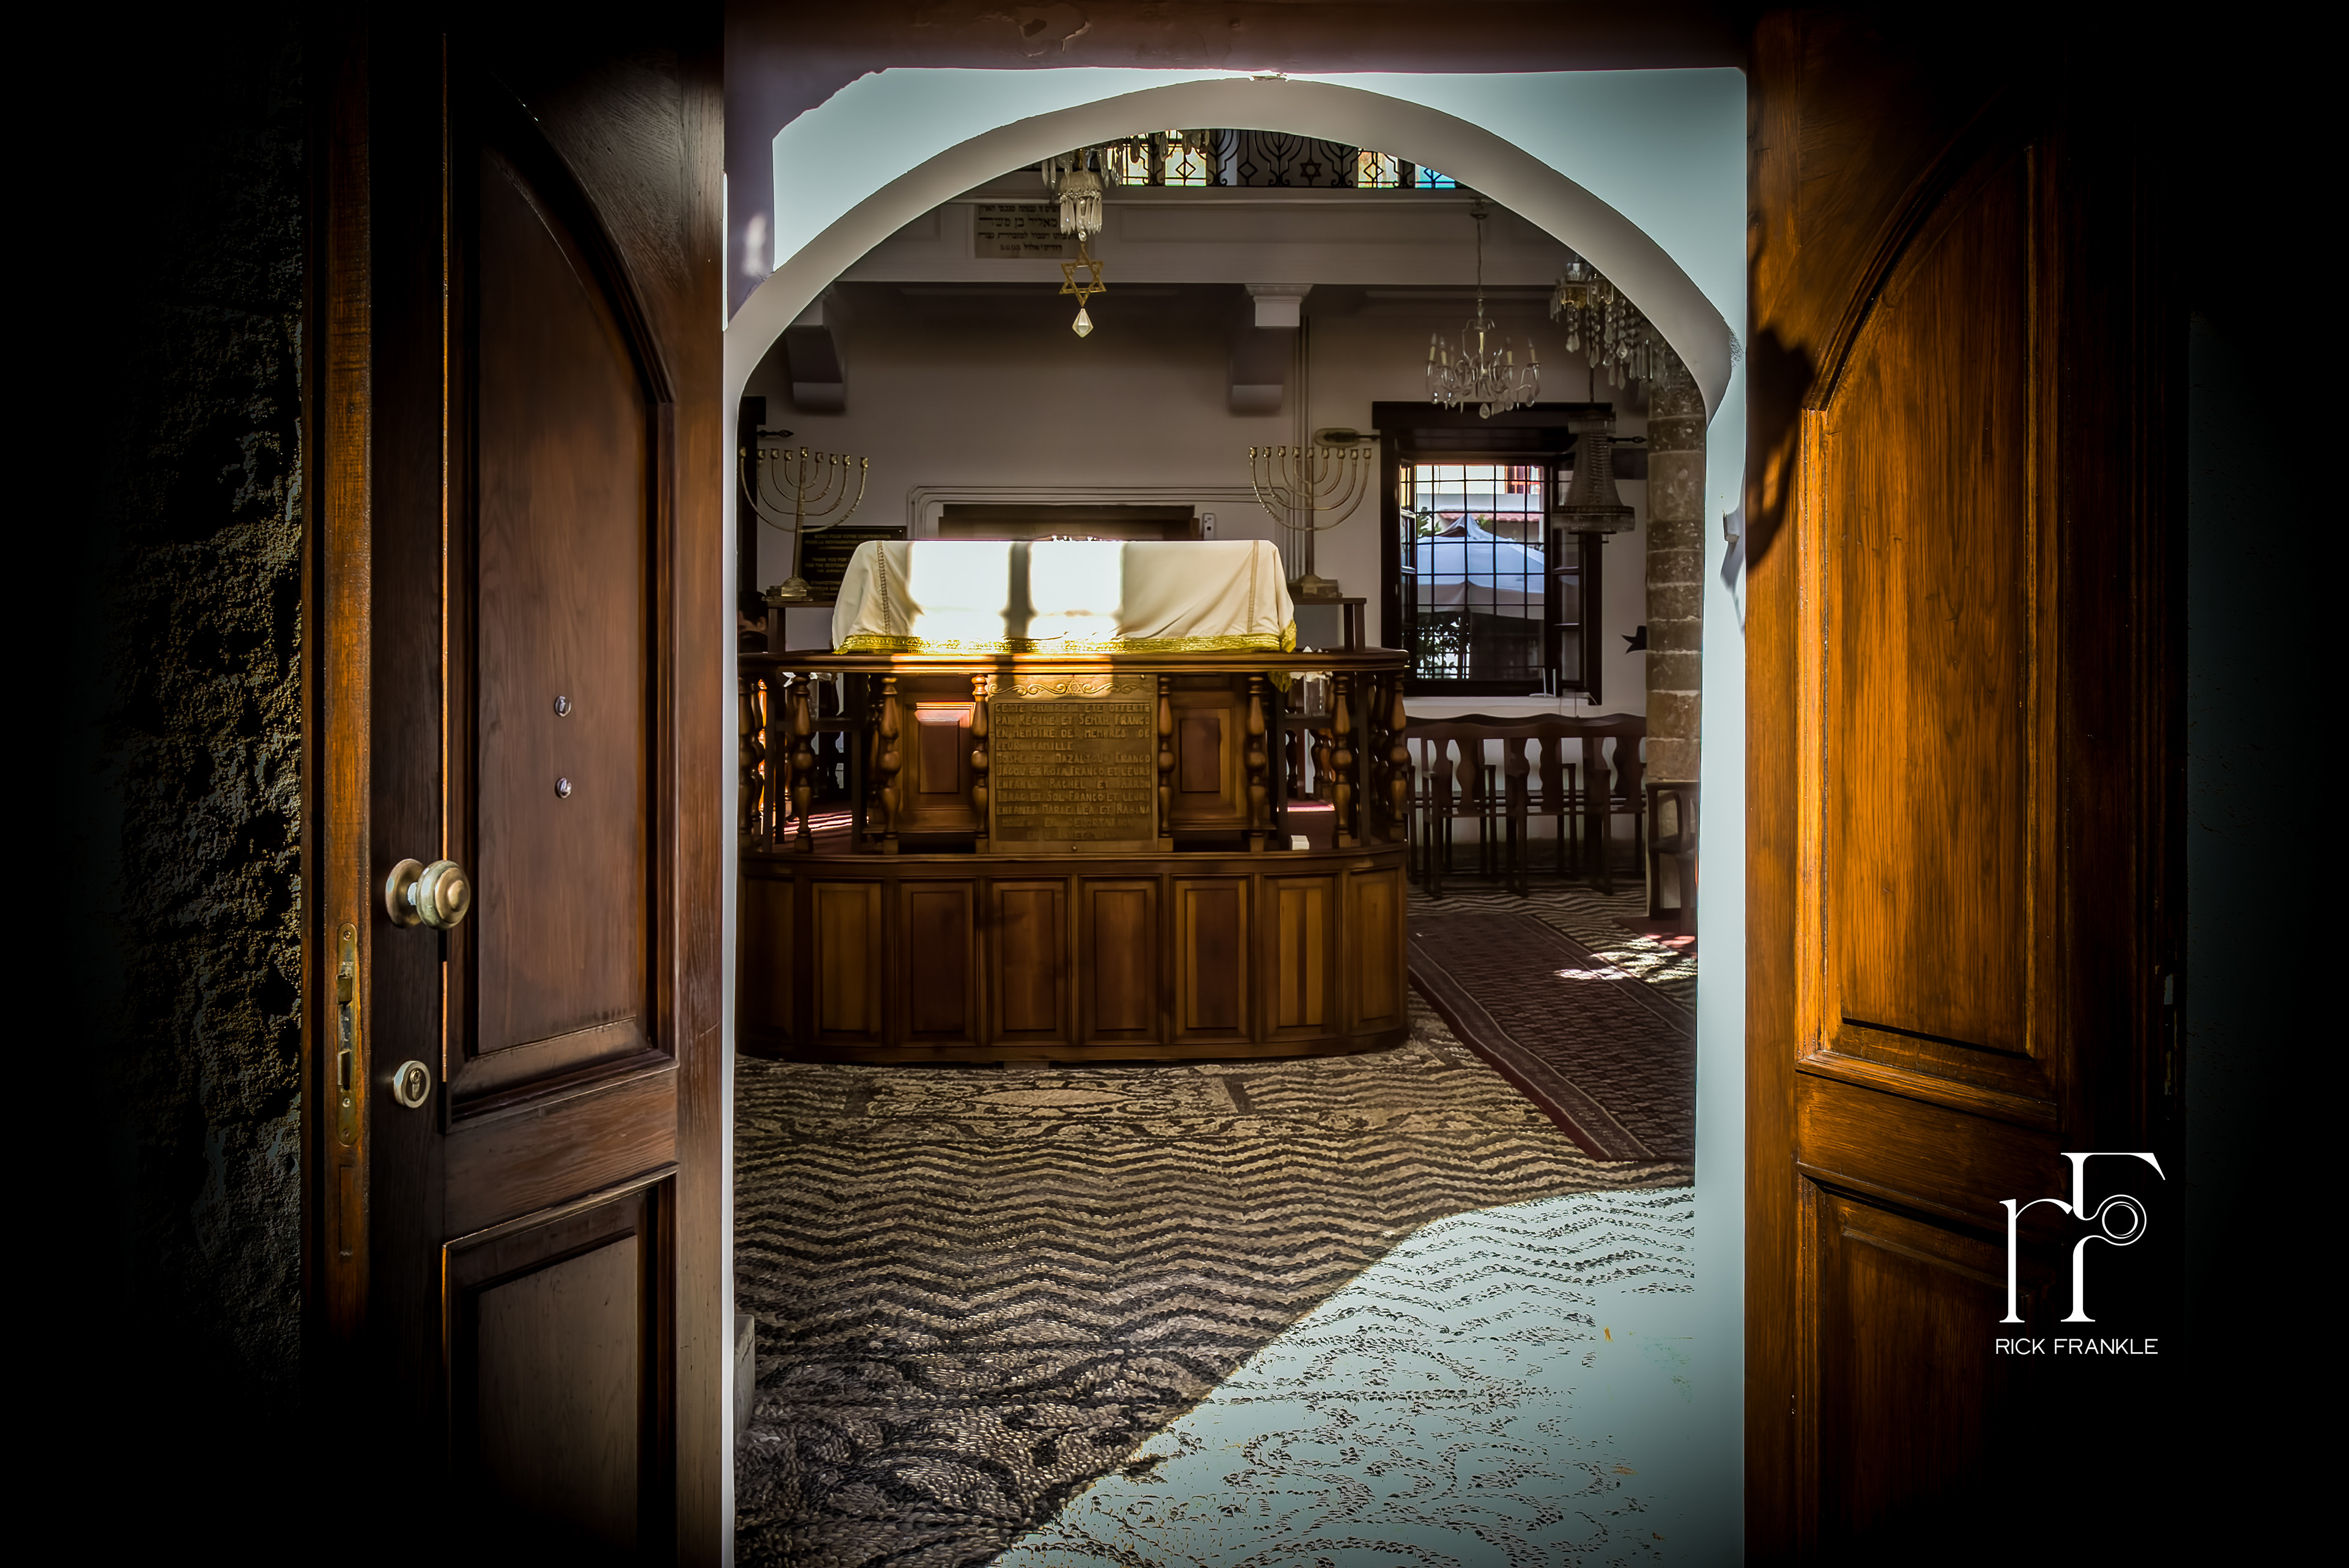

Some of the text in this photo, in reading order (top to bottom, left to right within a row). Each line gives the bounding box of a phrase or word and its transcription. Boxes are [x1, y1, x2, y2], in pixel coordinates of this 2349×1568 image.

[1014, 217, 1025, 229] בן
[995, 714, 1150, 725] PAR REGINE ET SEMAH FRANCO
[996, 728, 1150, 738] EN MEMOIRE DES MEMBRES DE
[1032, 741, 1074, 751] FAMILLE
[1033, 755, 1044, 763] ET
[1115, 753, 1151, 763] FRANCO
[1069, 765, 1104, 775] FRANCO
[1107, 767, 1119, 775] ET
[1121, 767, 1150, 775] LEURS
[1050, 779, 1086, 789] RACHEL
[1030, 793, 1042, 802] ET
[1069, 791, 1103, 802] FRANCO
[1106, 793, 1118, 802] ET
[1122, 793, 1150, 802] LEURS
